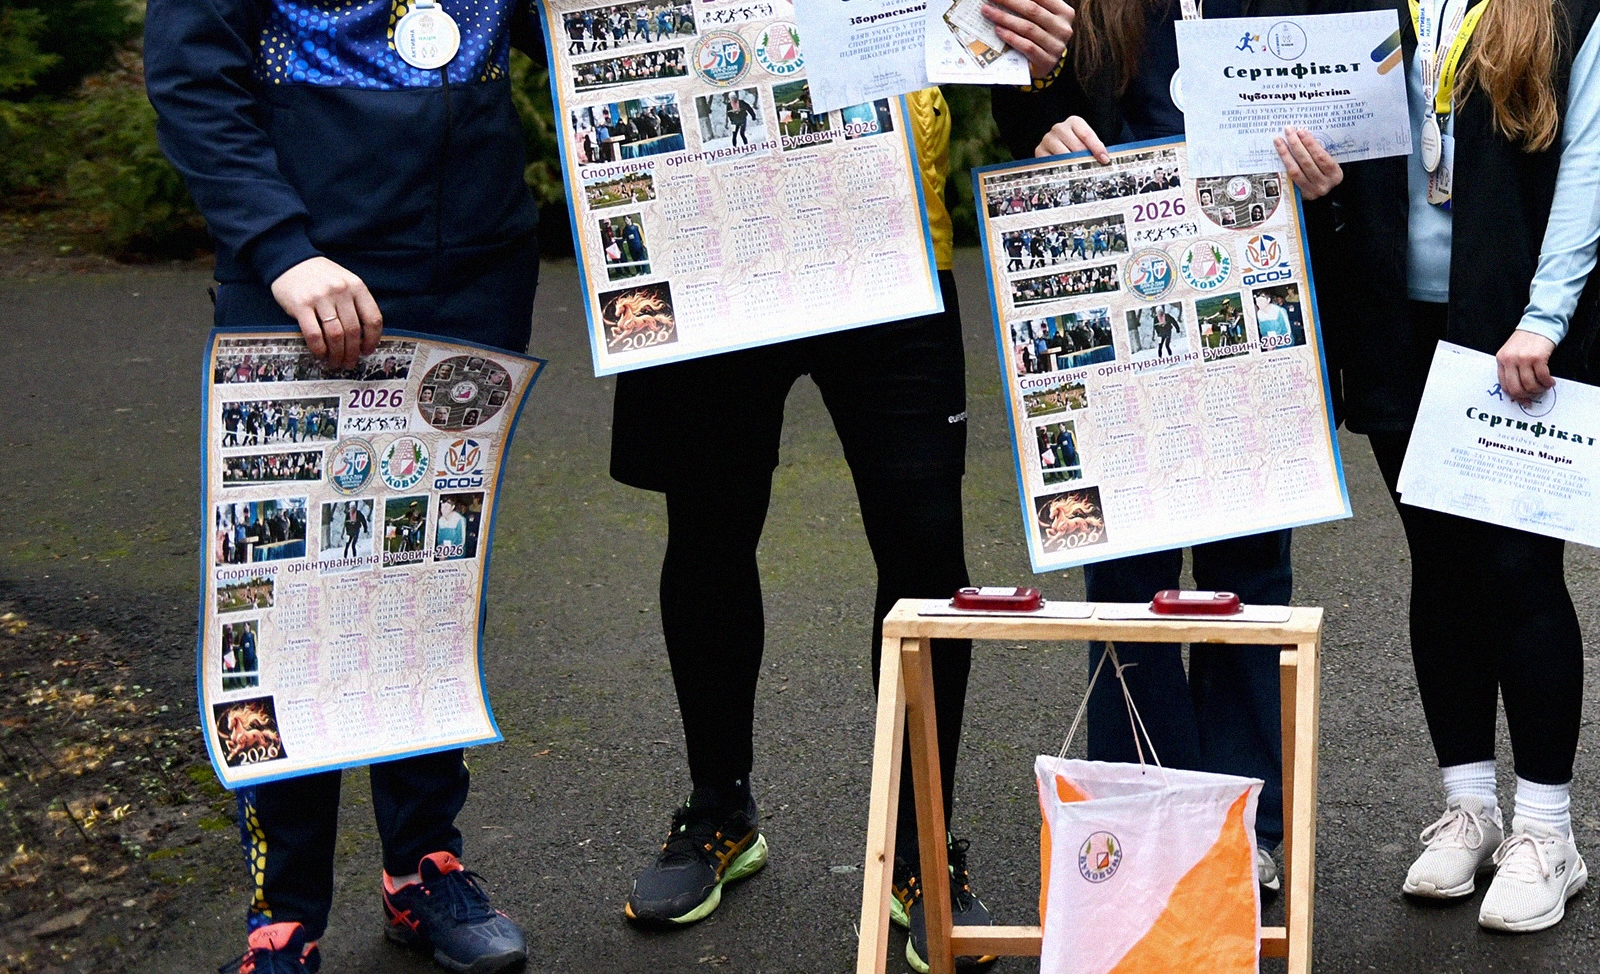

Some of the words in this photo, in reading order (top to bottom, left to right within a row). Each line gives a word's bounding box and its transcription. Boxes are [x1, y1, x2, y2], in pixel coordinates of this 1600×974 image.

[848, 3, 928, 26] Зборовський
[1224, 62, 1361, 81] Сертифікат
[1238, 92, 1296, 102] Чуботару
[1299, 88, 1351, 100] Крістіна
[1227, 114, 1270, 123] СПОРТИВНЕ
[1272, 110, 1327, 120] ОРІЄНТУВАННЯ
[1259, 106, 1287, 114] УЧАСТЬ
[1326, 113, 1374, 122] АКТИВНОСТІ
[1325, 121, 1356, 129] УМОВАХ
[581, 159, 656, 180] Спортивне
[666, 143, 758, 168] орієнтування
[762, 138, 776, 150] на
[781, 120, 878, 148] Буковині-2026
[1132, 198, 1186, 223] 2026
[1182, 257, 1230, 288] БУКОВИНА
[622, 329, 669, 352] 2026
[1019, 368, 1088, 390] Спортивне
[1098, 354, 1180, 376] орієнтування
[1184, 350, 1199, 362] на
[1202, 335, 1292, 359] Буковині-2026
[348, 388, 404, 408] 2026
[1466, 406, 1596, 446] Сертифікат
[1477, 437, 1535, 457] Приказка
[1537, 450, 1573, 466] Марія
[380, 456, 428, 488] БУКОВИНА
[1057, 532, 1100, 551] 2026
[216, 564, 278, 581] Спортивне
[287, 556, 363, 574] орієнтування
[366, 556, 379, 564] на
[382, 544, 464, 564] Буковині-2026
[240, 744, 278, 764] 2026
